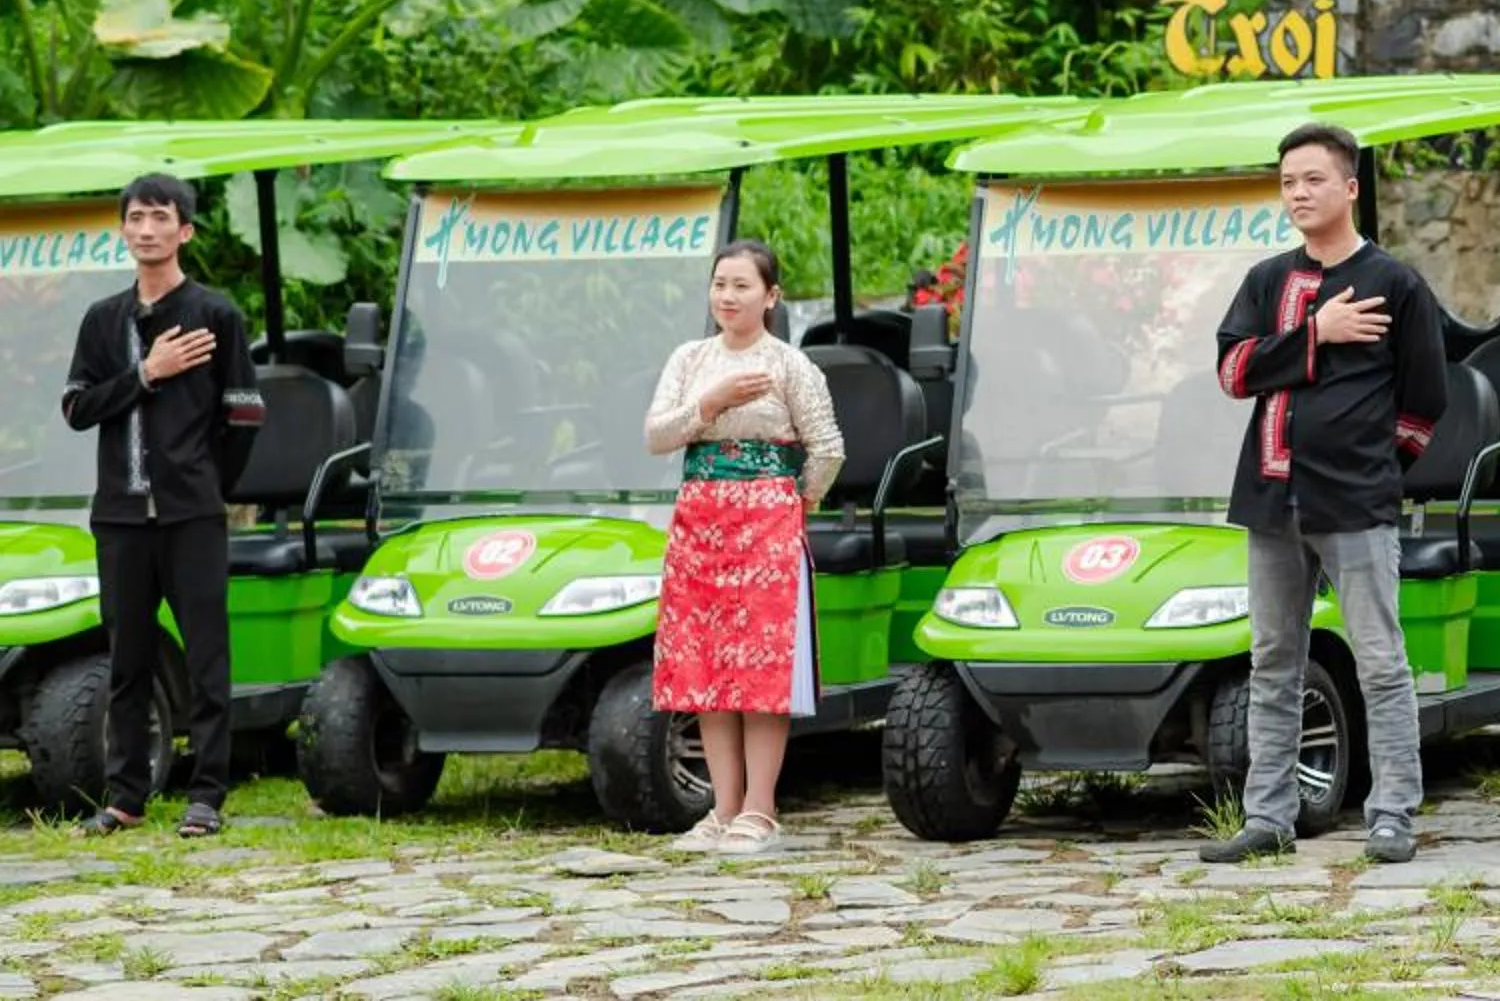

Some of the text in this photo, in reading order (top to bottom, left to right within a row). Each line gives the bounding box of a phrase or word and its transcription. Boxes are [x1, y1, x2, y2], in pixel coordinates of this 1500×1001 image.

[572, 215, 710, 254] VILLAGE
[477, 539, 524, 565] 02
[1079, 544, 1126, 569] 03
[1050, 611, 1108, 624] LVTONG
